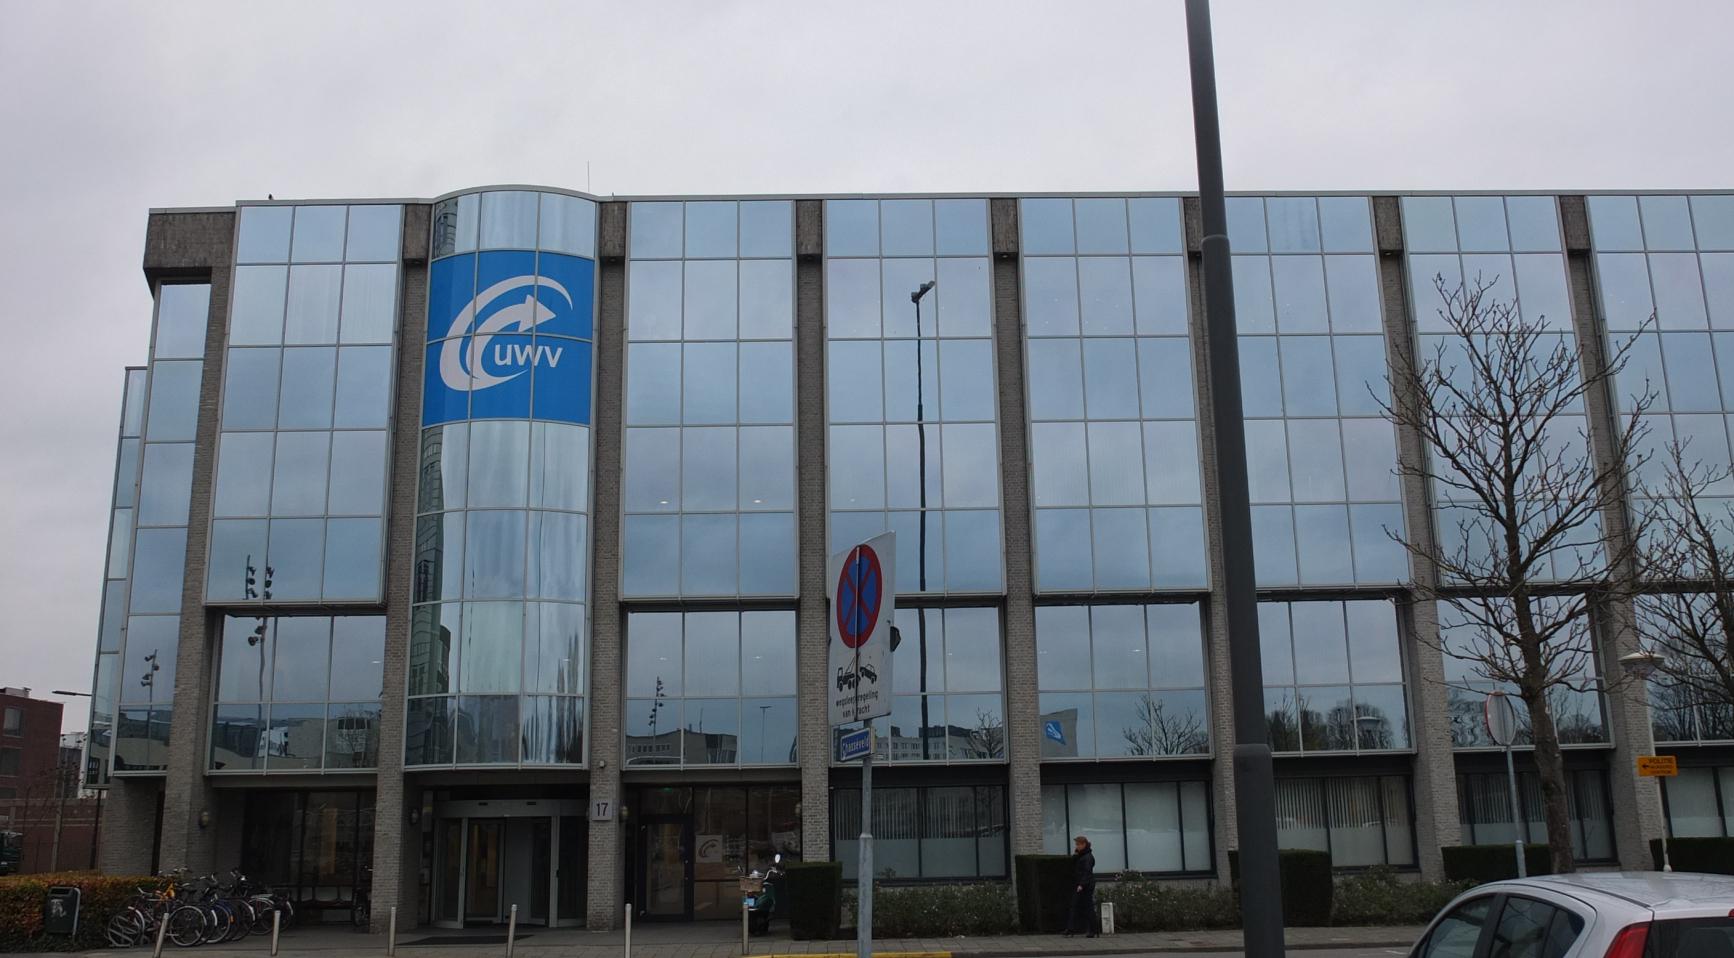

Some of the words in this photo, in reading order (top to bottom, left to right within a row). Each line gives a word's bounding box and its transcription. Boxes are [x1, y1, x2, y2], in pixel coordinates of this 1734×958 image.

[494, 344, 563, 368] uwv
[842, 709, 852, 718] van
[596, 802, 608, 817] 17
